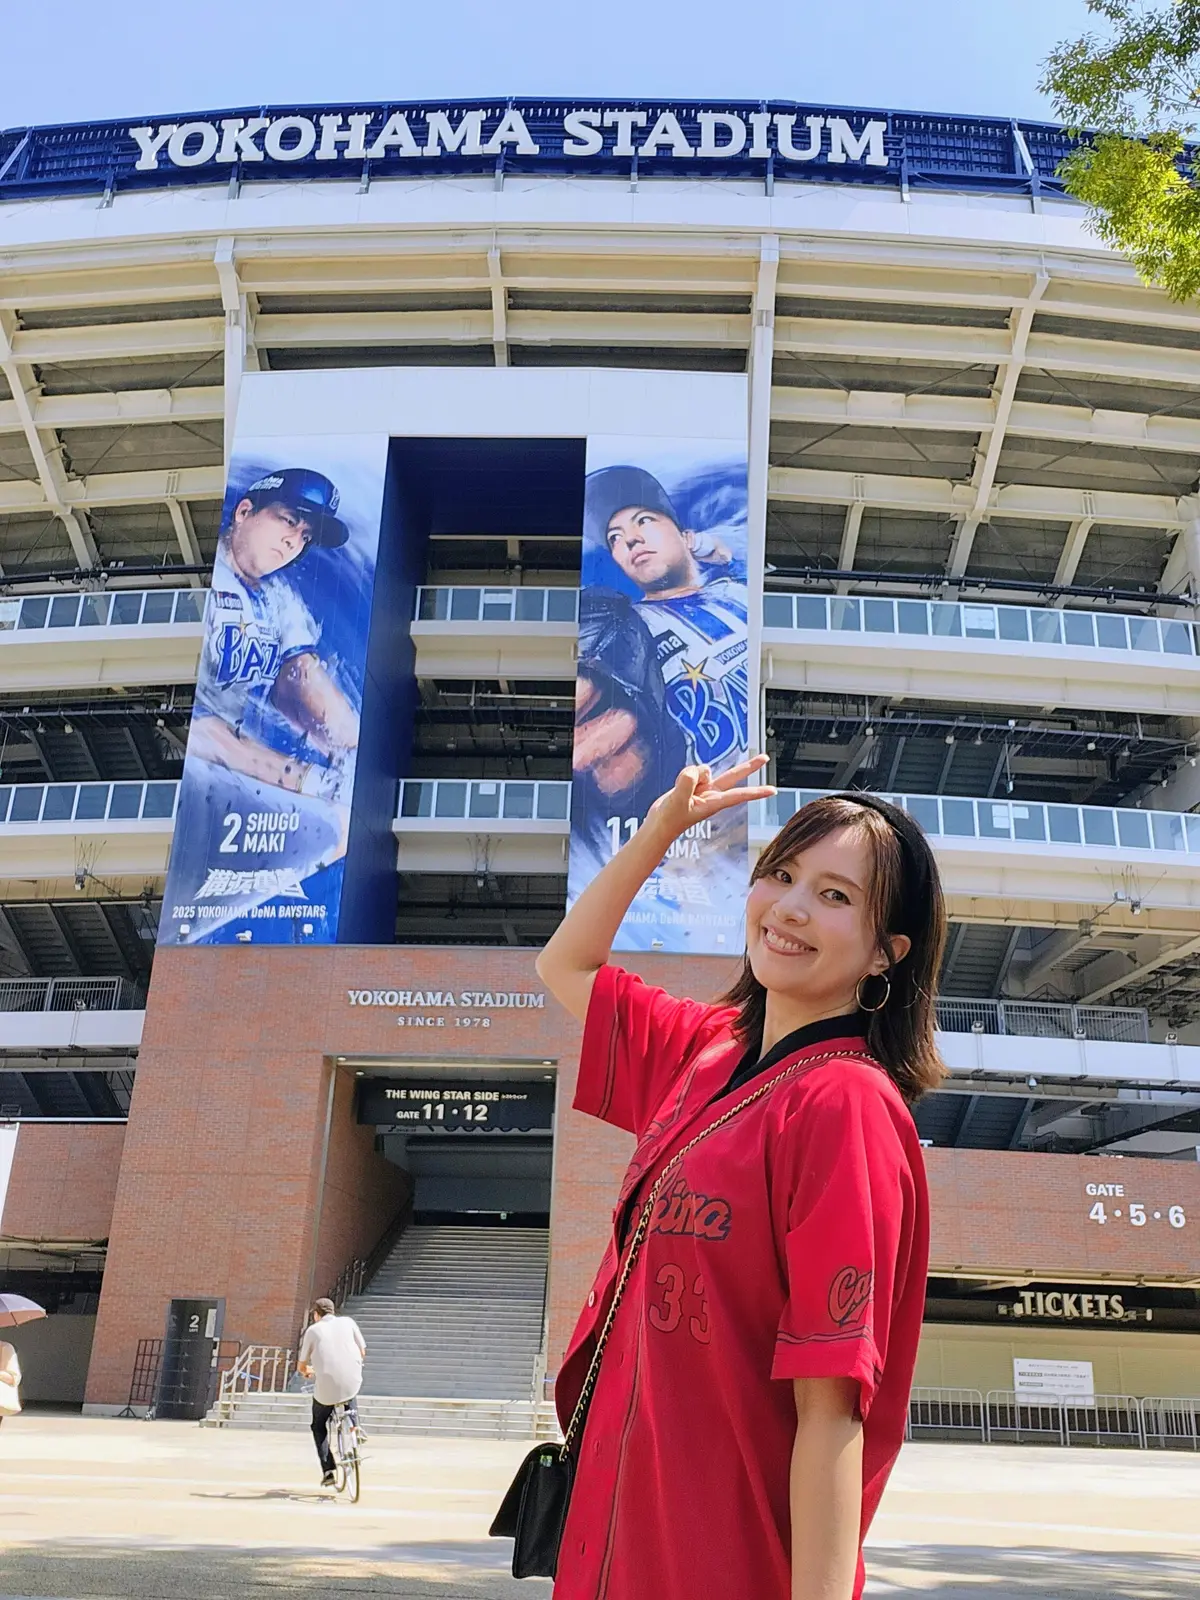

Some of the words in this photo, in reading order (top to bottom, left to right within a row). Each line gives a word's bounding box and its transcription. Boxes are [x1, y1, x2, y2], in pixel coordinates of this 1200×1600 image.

[130, 109, 540, 171] YOKOHAMA
[562, 110, 889, 167] STADIUM
[246, 812, 300, 833] SHUGO
[679, 819, 712, 839] UKI
[219, 812, 242, 853] 2
[606, 816, 639, 856] 11
[242, 833, 286, 853] MAKI
[664, 841, 700, 859] UMA
[172, 905, 196, 919] 2025
[197, 905, 249, 919] YOKOHAMA
[251, 905, 277, 919] DeNA
[278, 904, 327, 919] BAYSTARS
[348, 990, 456, 1007] YOKOHAMA
[460, 992, 545, 1009] STADIUM
[397, 1016, 445, 1027] SINCE
[454, 1017, 491, 1028] 1978
[385, 1089, 407, 1100] THE
[409, 1089, 440, 1101] WING
[443, 1090, 472, 1101] STAR
[474, 1090, 500, 1101] SIDE
[396, 1110, 420, 1120] GATE
[1085, 1183, 1125, 1197] GATE
[1018, 1290, 1125, 1319] TICKETS
[189, 1314, 200, 1328] 2
